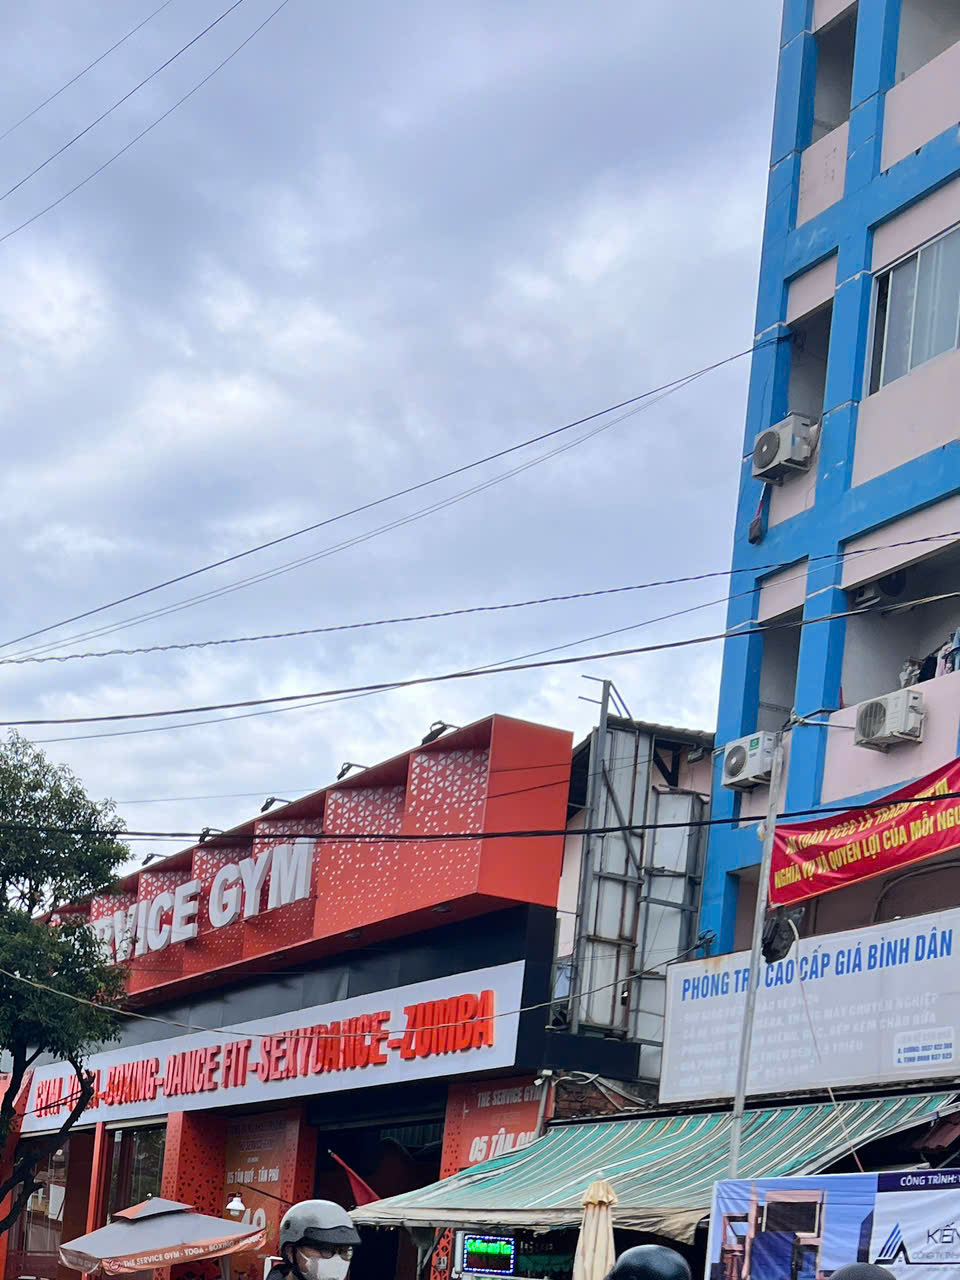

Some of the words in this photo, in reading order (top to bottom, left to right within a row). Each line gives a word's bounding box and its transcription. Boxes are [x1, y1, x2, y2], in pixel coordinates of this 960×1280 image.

[826, 820, 858, 842] PCCC
[882, 820, 909, 850] CỦA
[910, 810, 935, 841] MỖI
[209, 837, 317, 928] GYM
[682, 969, 729, 1001] PHÒNG
[765, 957, 794, 989] CAO
[800, 944, 831, 982] CẤP
[835, 941, 862, 976] GIÁ
[868, 936, 910, 969] BÌNH
[915, 926, 953, 961] DÂN
[469, 1135, 489, 1162] 05
[900, 1175, 926, 1186] CÔNG
[927, 1173, 957, 1185] TRÌNH:
[136, 1253, 163, 1266] SERVICE
[164, 1250, 180, 1261] GYM
[184, 1246, 205, 1257] YOGA
